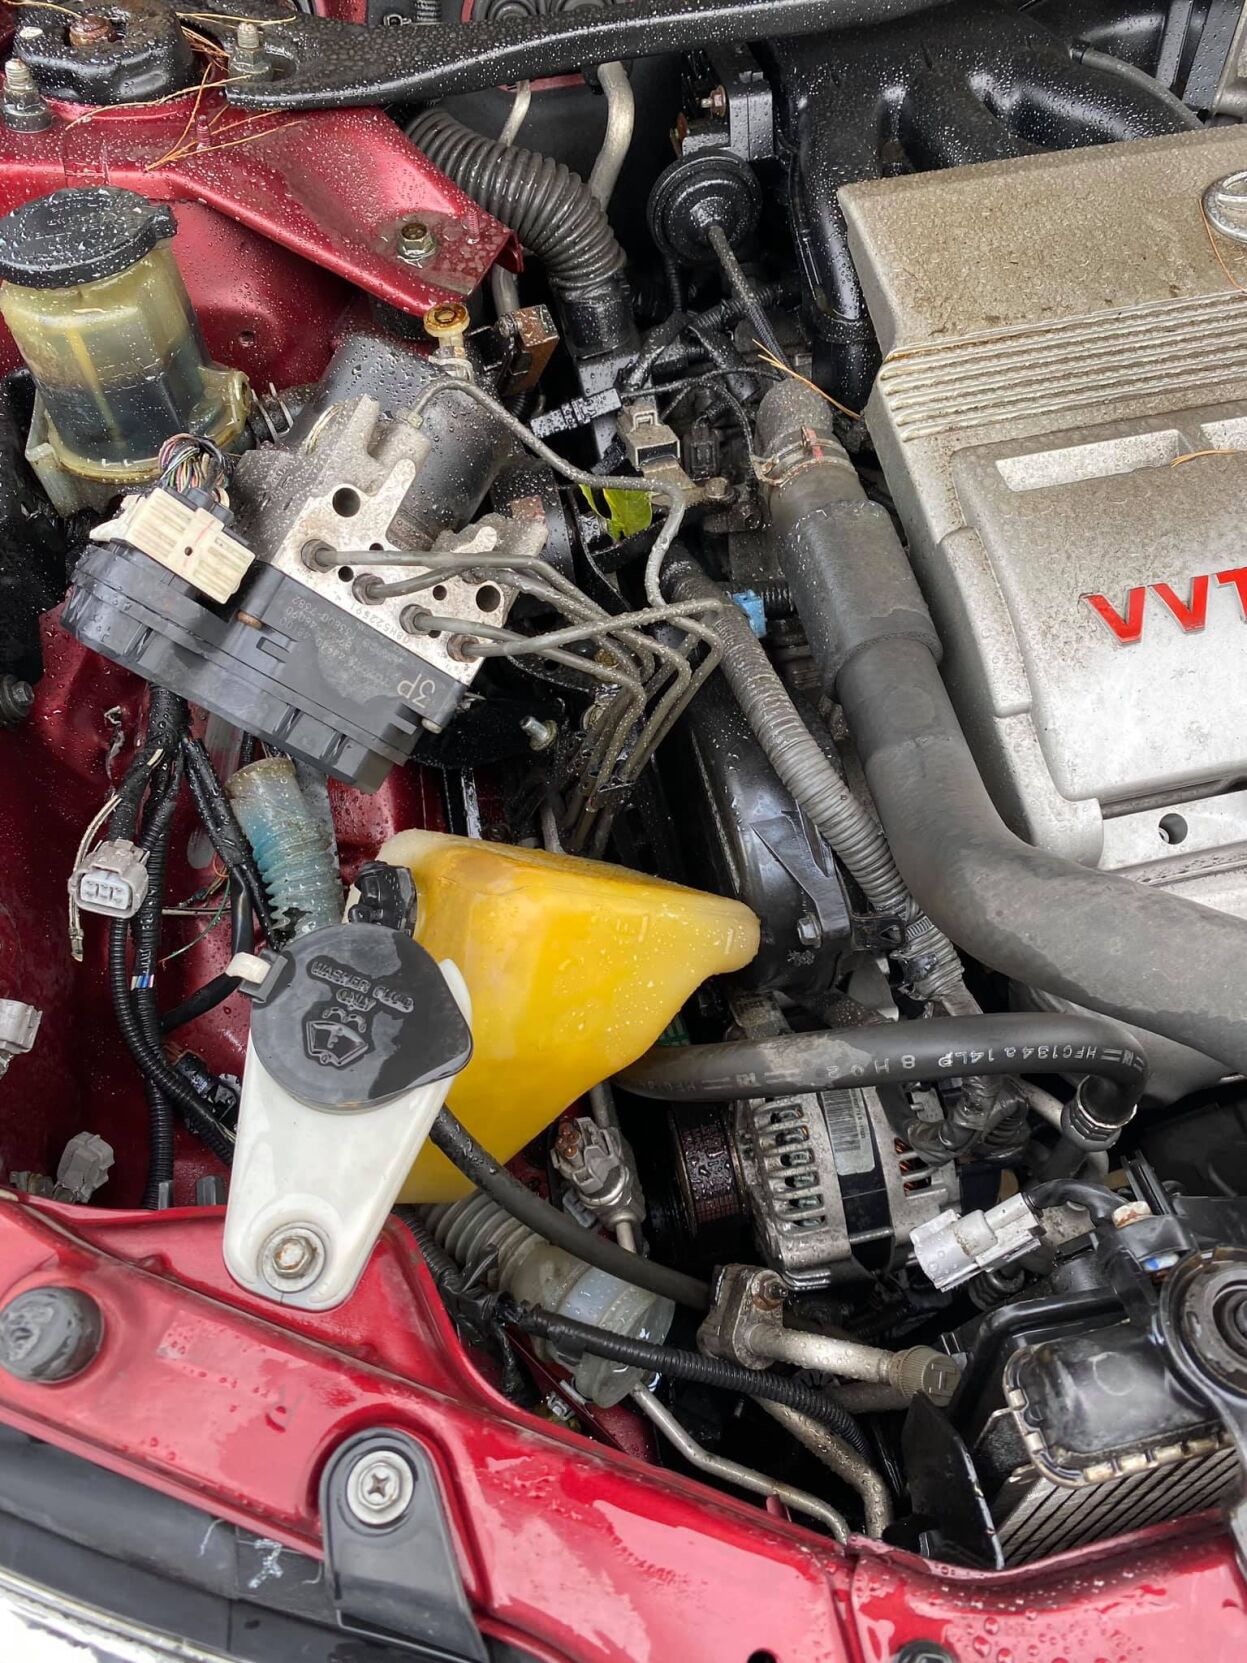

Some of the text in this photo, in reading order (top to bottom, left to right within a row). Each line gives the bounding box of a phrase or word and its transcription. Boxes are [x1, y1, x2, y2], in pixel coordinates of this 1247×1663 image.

[397, 672, 436, 709] 3P
[311, 961, 371, 993] WASHER
[336, 988, 376, 1012] ONLY
[938, 1048, 994, 1067] 14LP
[1004, 1044, 1097, 1061] HFC134a
